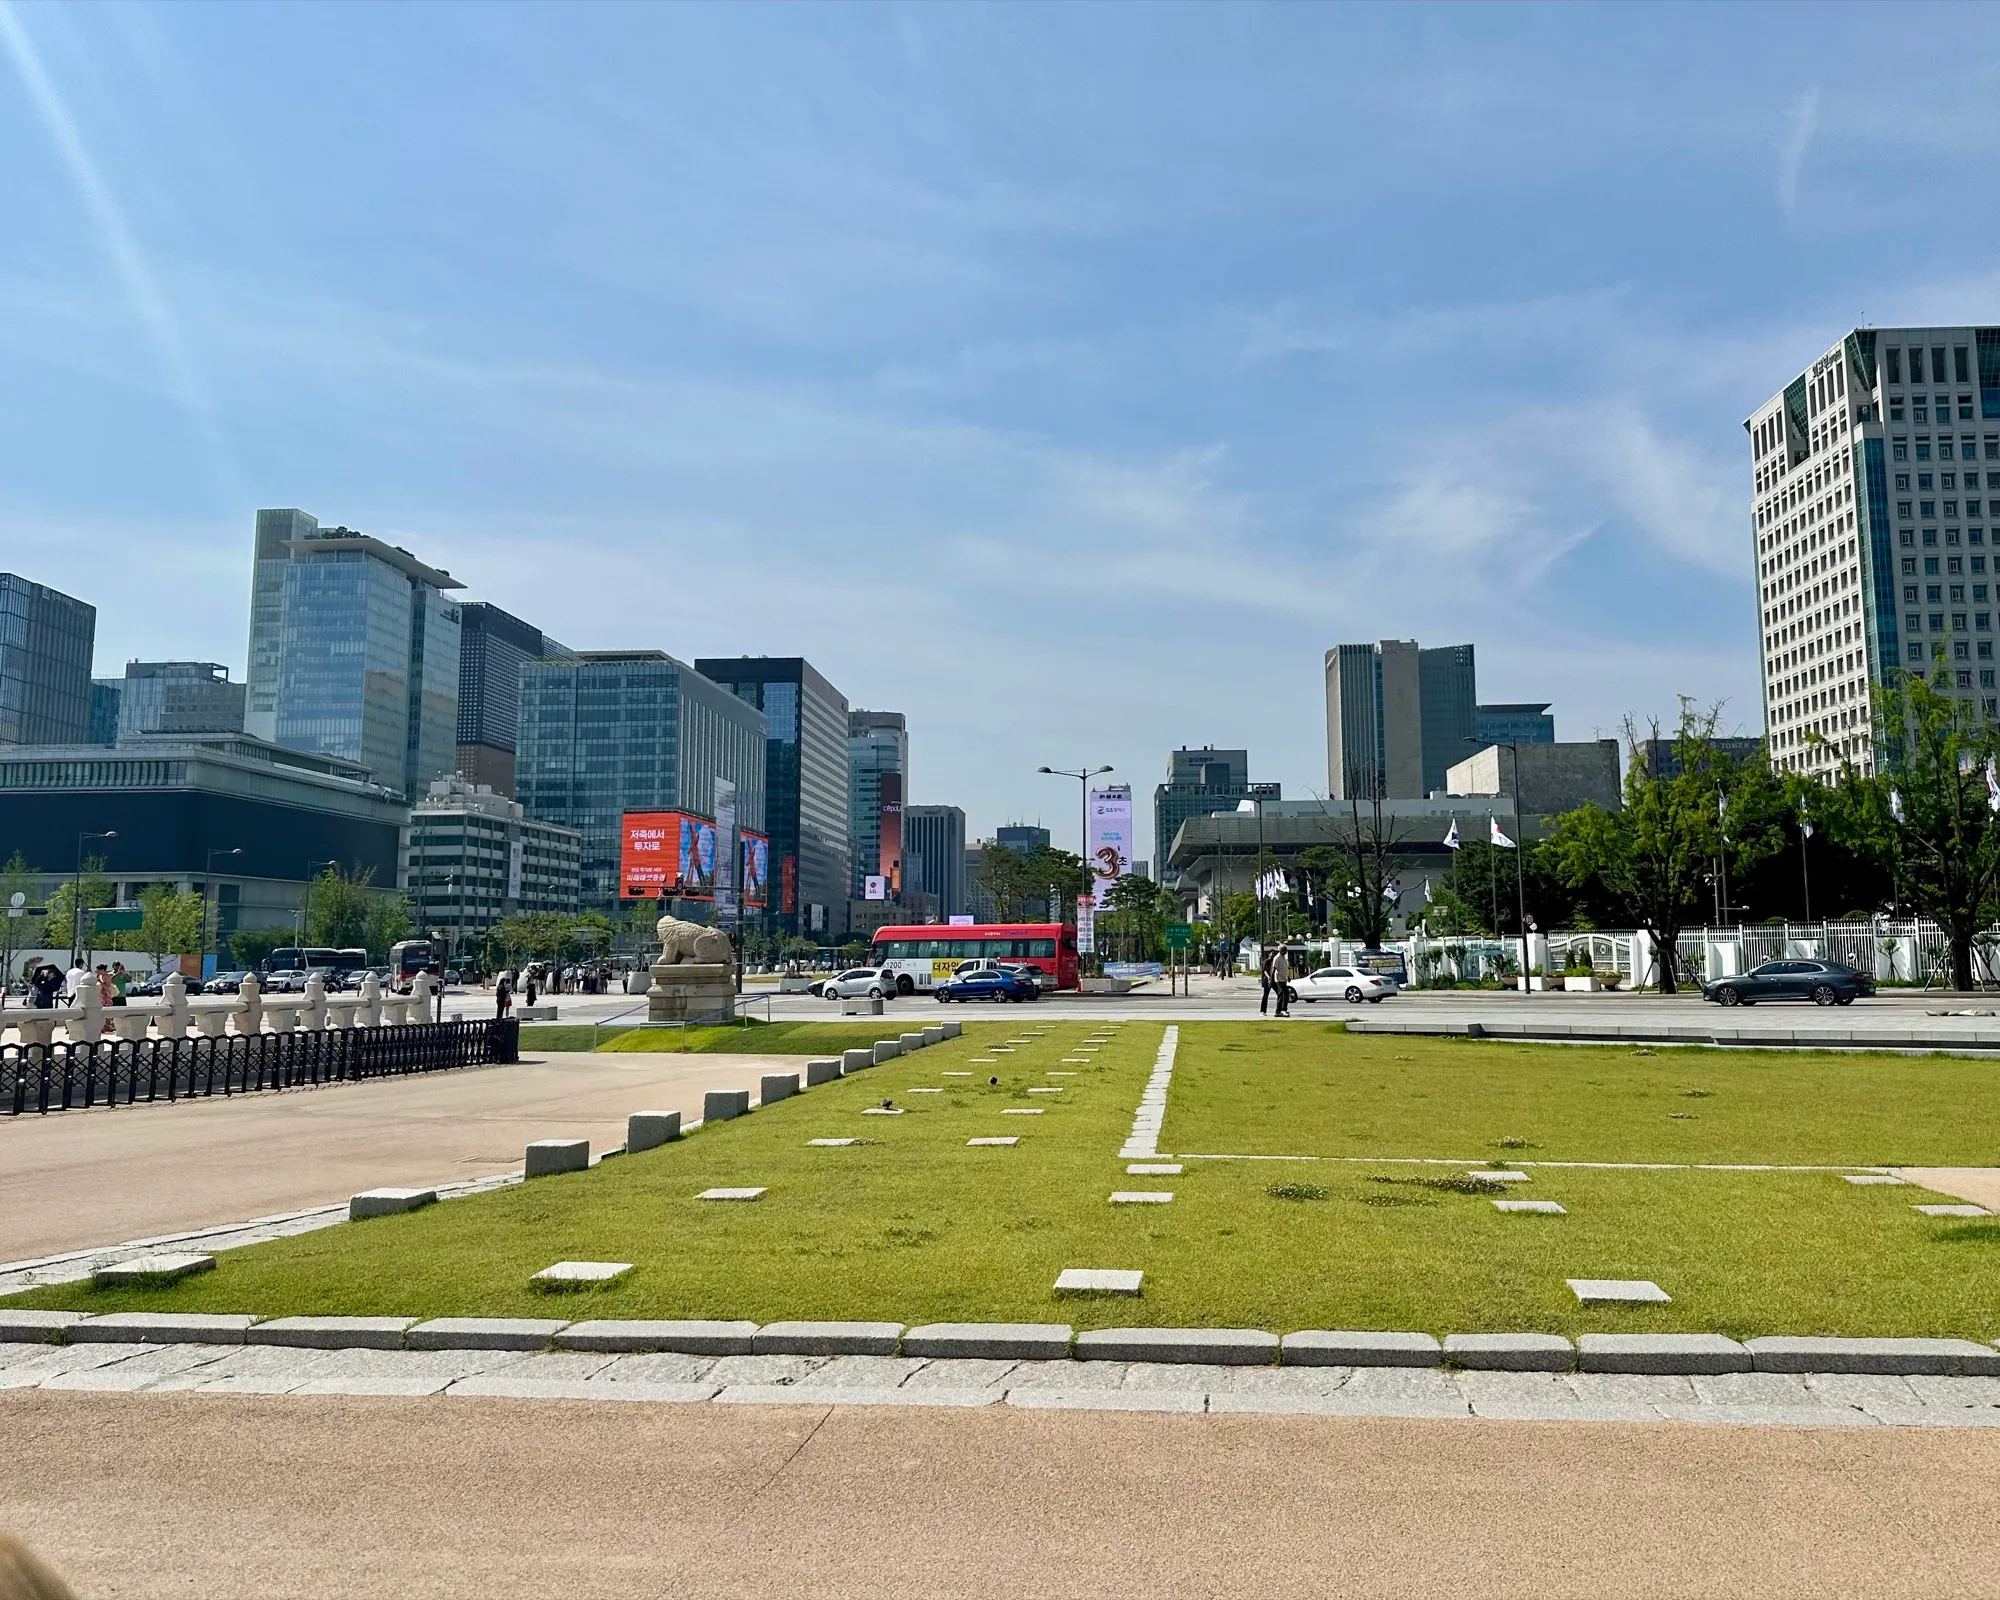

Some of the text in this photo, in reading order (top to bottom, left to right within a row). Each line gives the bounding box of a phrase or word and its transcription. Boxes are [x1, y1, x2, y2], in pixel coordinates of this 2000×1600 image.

[630, 829, 664, 839] 저축에서
[634, 841, 660, 850] 투자로
[886, 961, 902, 969] 1200
